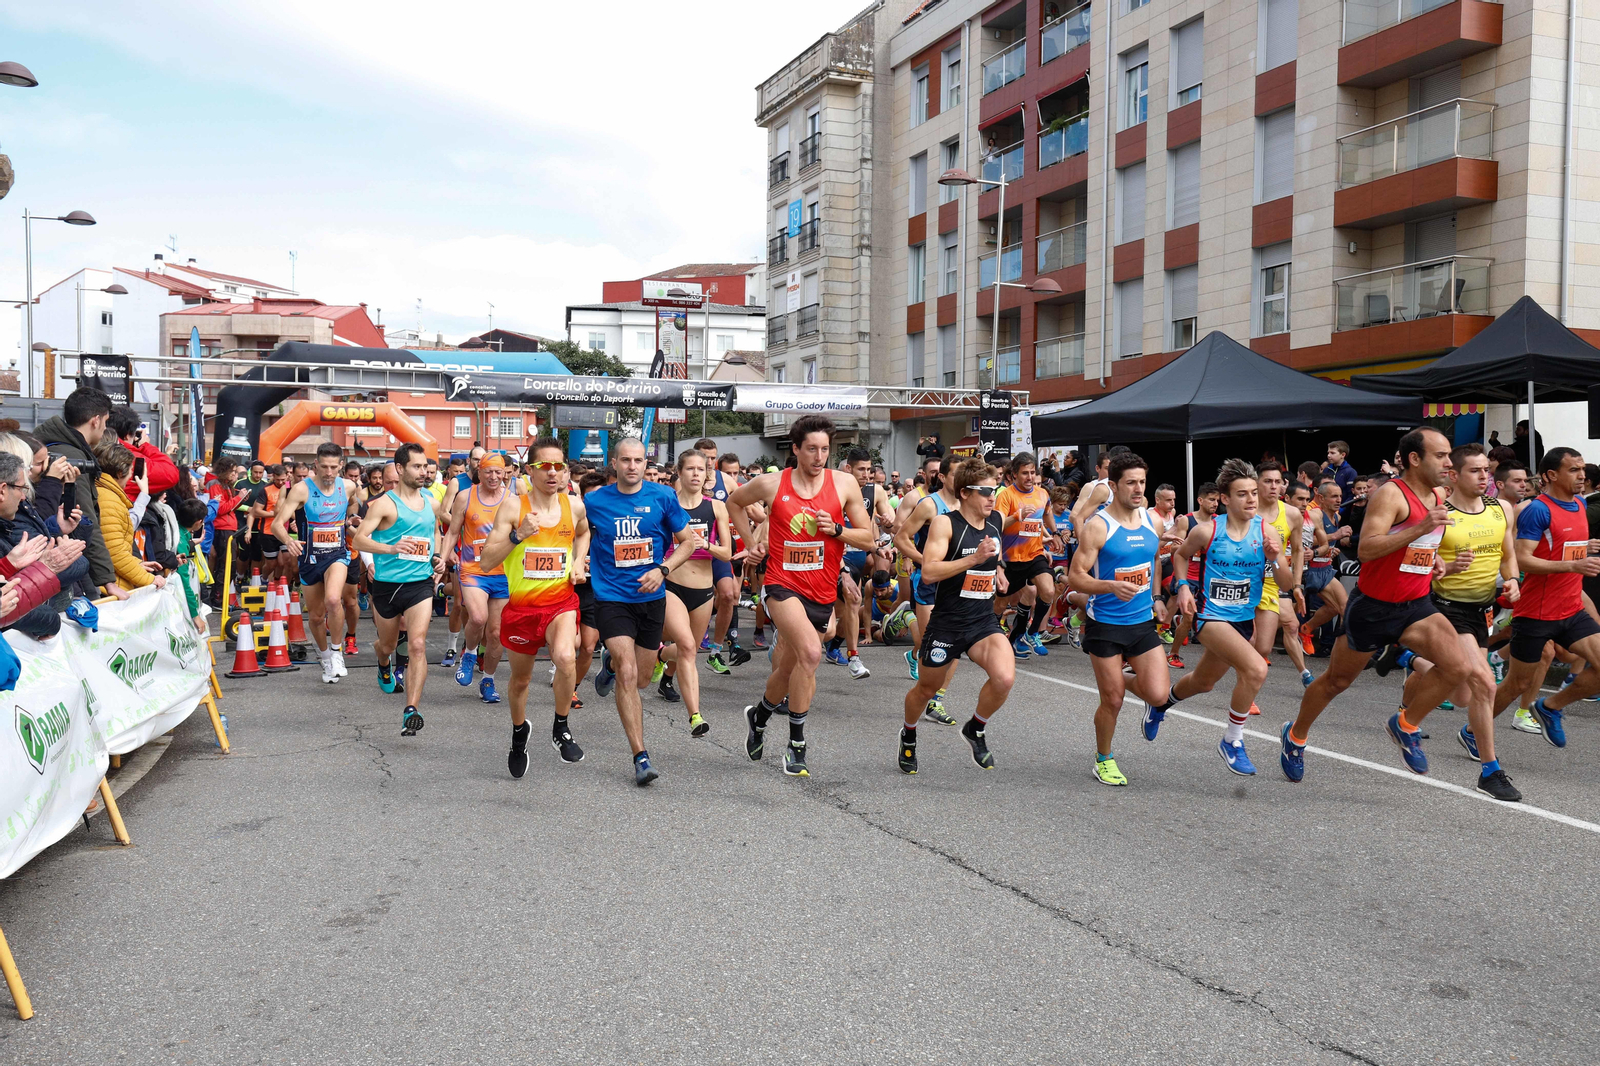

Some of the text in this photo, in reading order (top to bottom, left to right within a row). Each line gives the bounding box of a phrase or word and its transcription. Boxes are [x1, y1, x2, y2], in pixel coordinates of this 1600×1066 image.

[790, 208, 799, 228] 19
[524, 378, 660, 394] Concello do Porriño
[546, 392, 554, 400] O
[555, 393, 589, 402] Concello
[603, 395, 634, 404] Deporte
[698, 398, 728, 407] Porriño
[765, 400, 793, 410] Grupo
[796, 402, 825, 411] Godoy
[323, 408, 374, 420] GADIS
[614, 519, 641, 537] 10K
[318, 534, 336, 542] 1043
[622, 547, 642, 560] 237
[790, 551, 814, 563] 1075
[1411, 553, 1431, 566] 350
[536, 557, 554, 570] 123
[970, 580, 989, 591] 962
[1216, 587, 1241, 600] 1596
[128, 651, 158, 681] RAMA
[36, 702, 70, 748] RAMA
